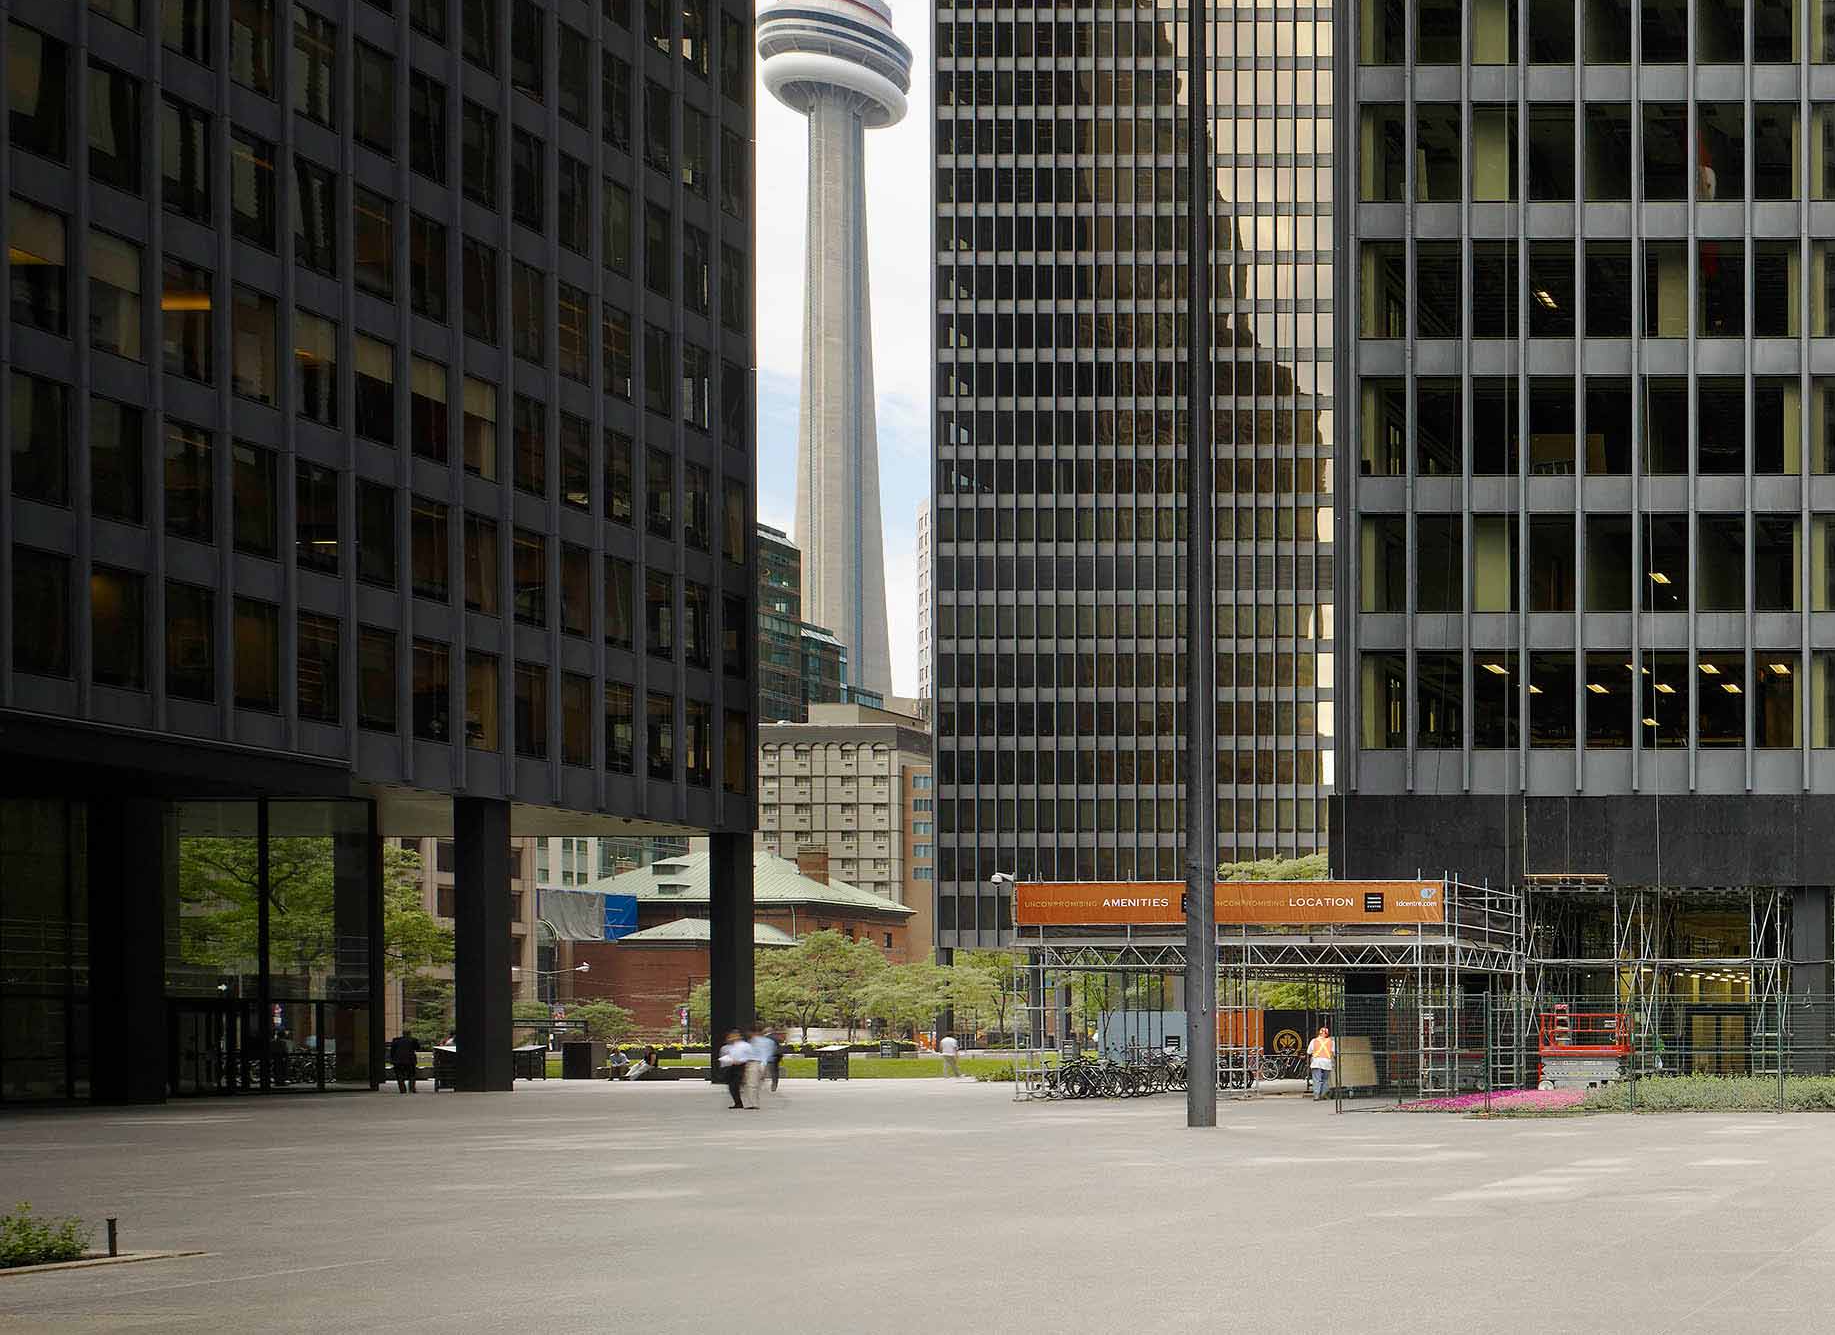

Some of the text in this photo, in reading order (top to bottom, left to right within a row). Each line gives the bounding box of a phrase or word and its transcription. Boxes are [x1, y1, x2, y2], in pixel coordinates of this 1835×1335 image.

[1102, 898, 1169, 907] AMENITIES
[1215, 897, 1354, 907] NCOMPROMISING LOCATION
[1395, 899, 1437, 907] tdcentre.com
